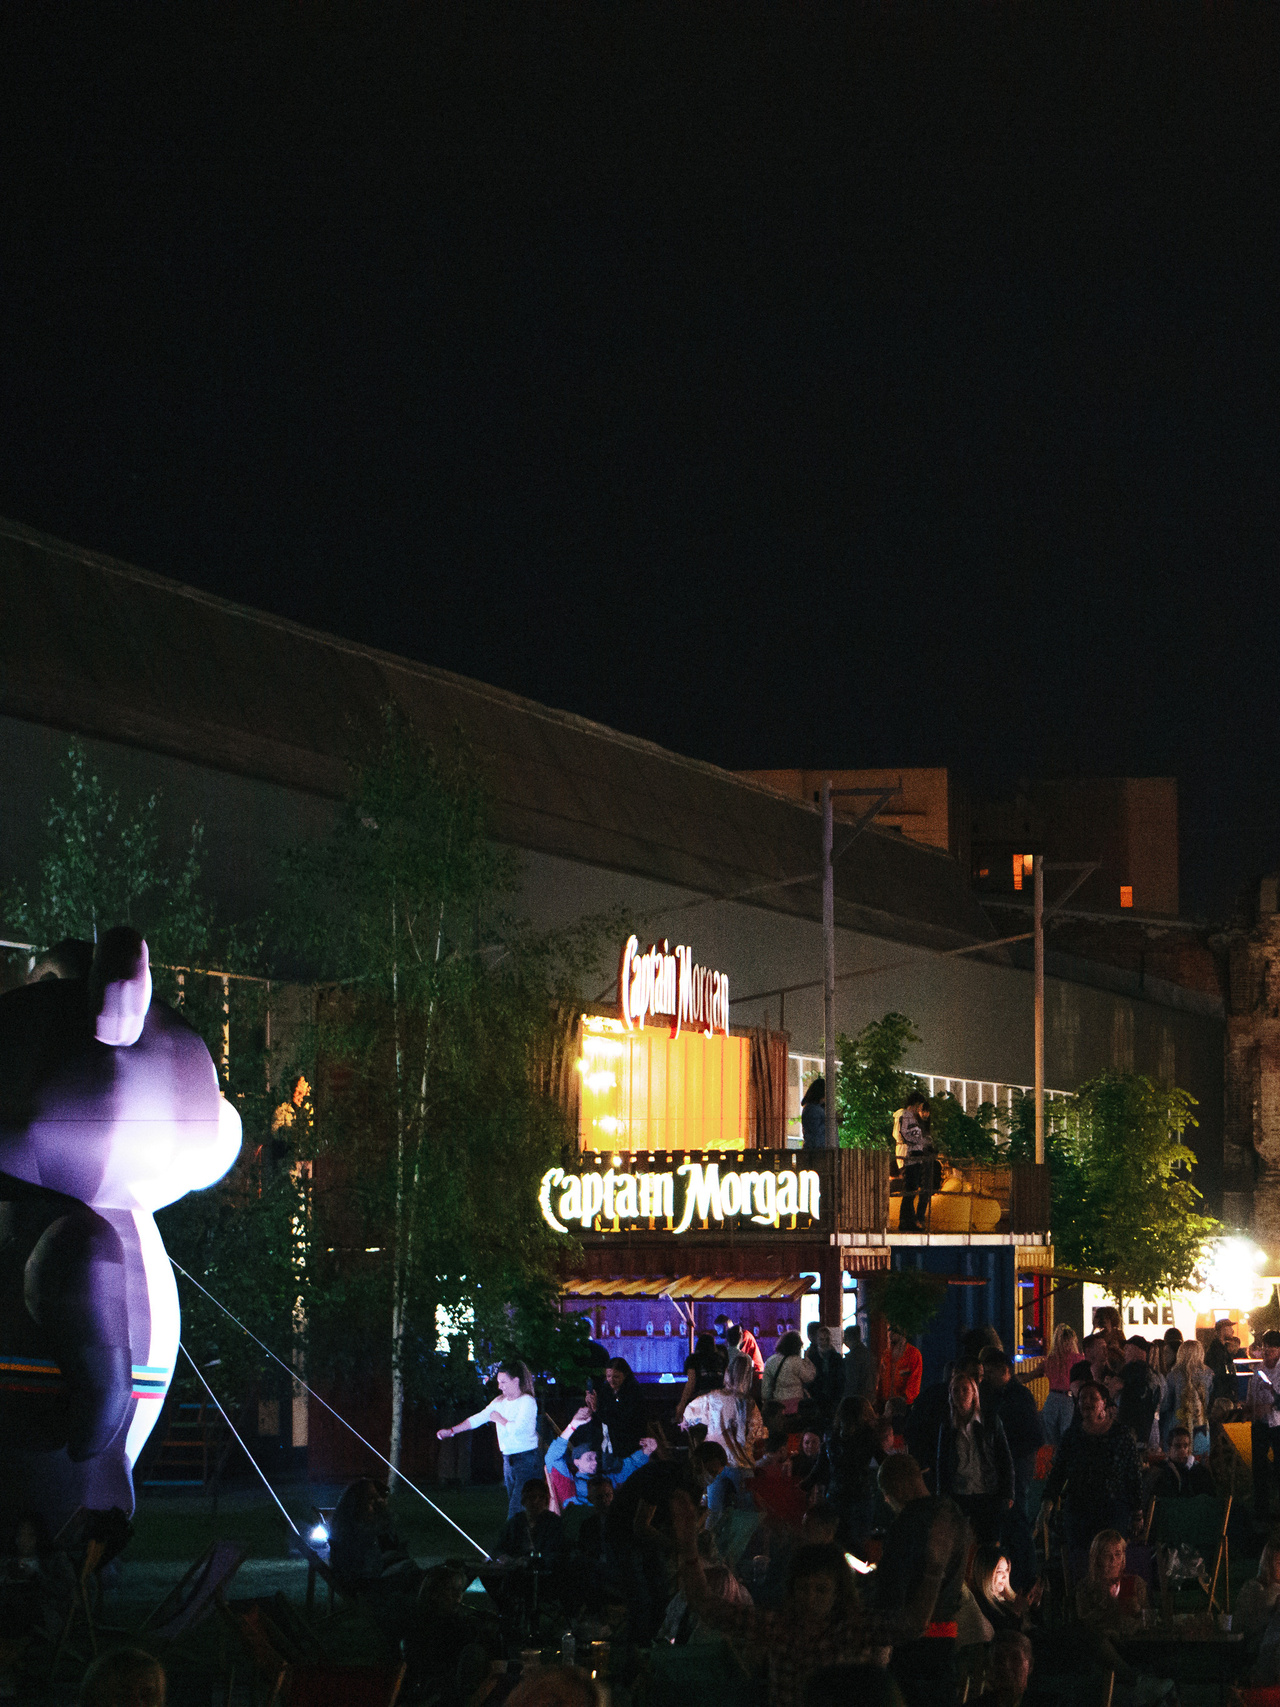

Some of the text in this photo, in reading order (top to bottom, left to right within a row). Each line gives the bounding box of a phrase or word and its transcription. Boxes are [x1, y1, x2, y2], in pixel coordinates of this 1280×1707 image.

[622, 934, 729, 1039] Captain Morgan
[538, 1163, 821, 1234] Captain Morgan
